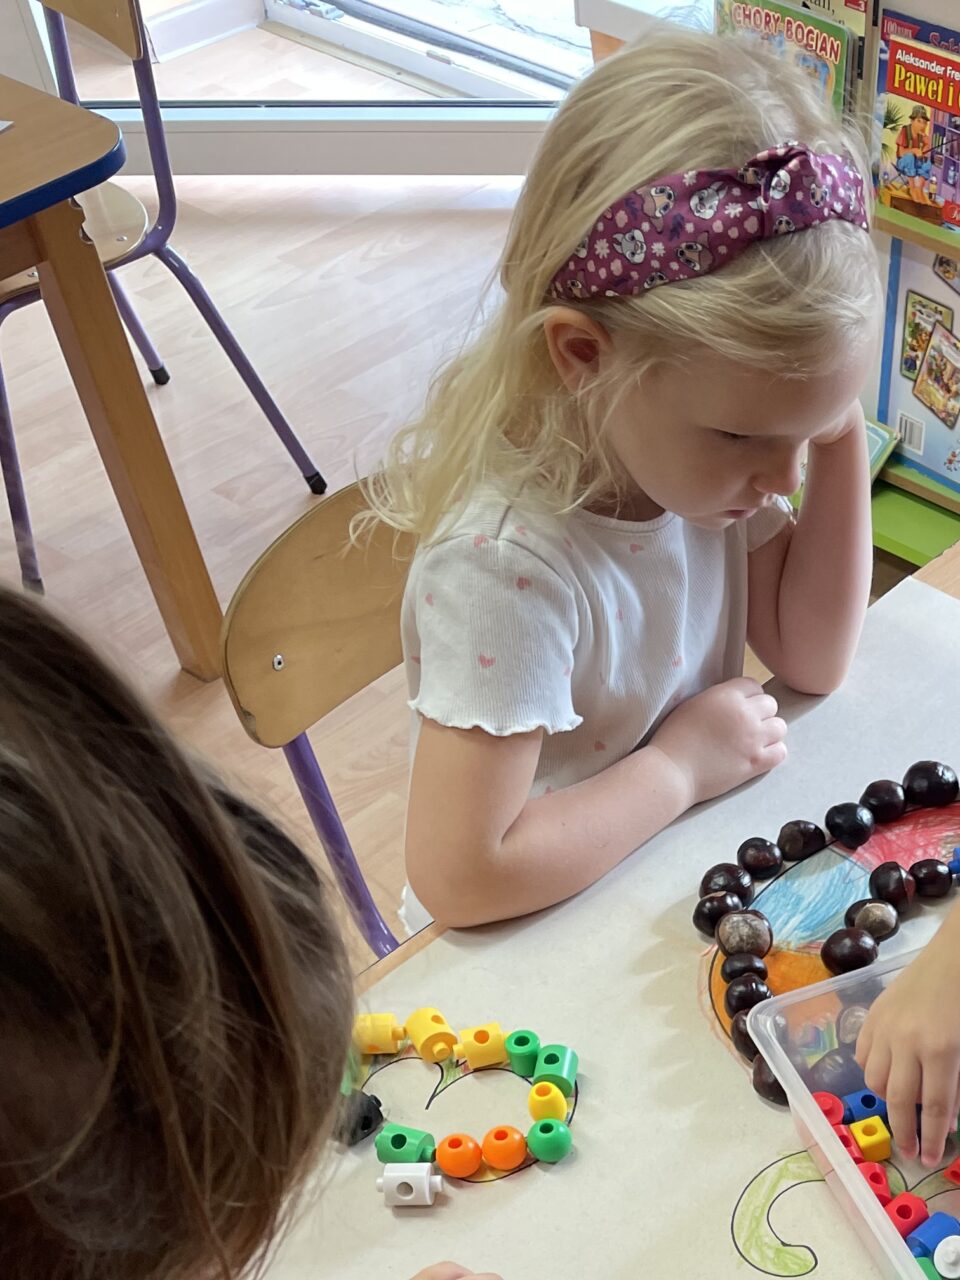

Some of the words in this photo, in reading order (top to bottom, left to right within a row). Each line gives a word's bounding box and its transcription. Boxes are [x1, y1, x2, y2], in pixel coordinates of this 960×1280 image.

[731, 3, 781, 35] CHORY
[784, 17, 841, 64] BOCIAN
[896, 49, 945, 75] Aleksander
[894, 63, 943, 102] Paweł
[948, 83, 954, 106] i
